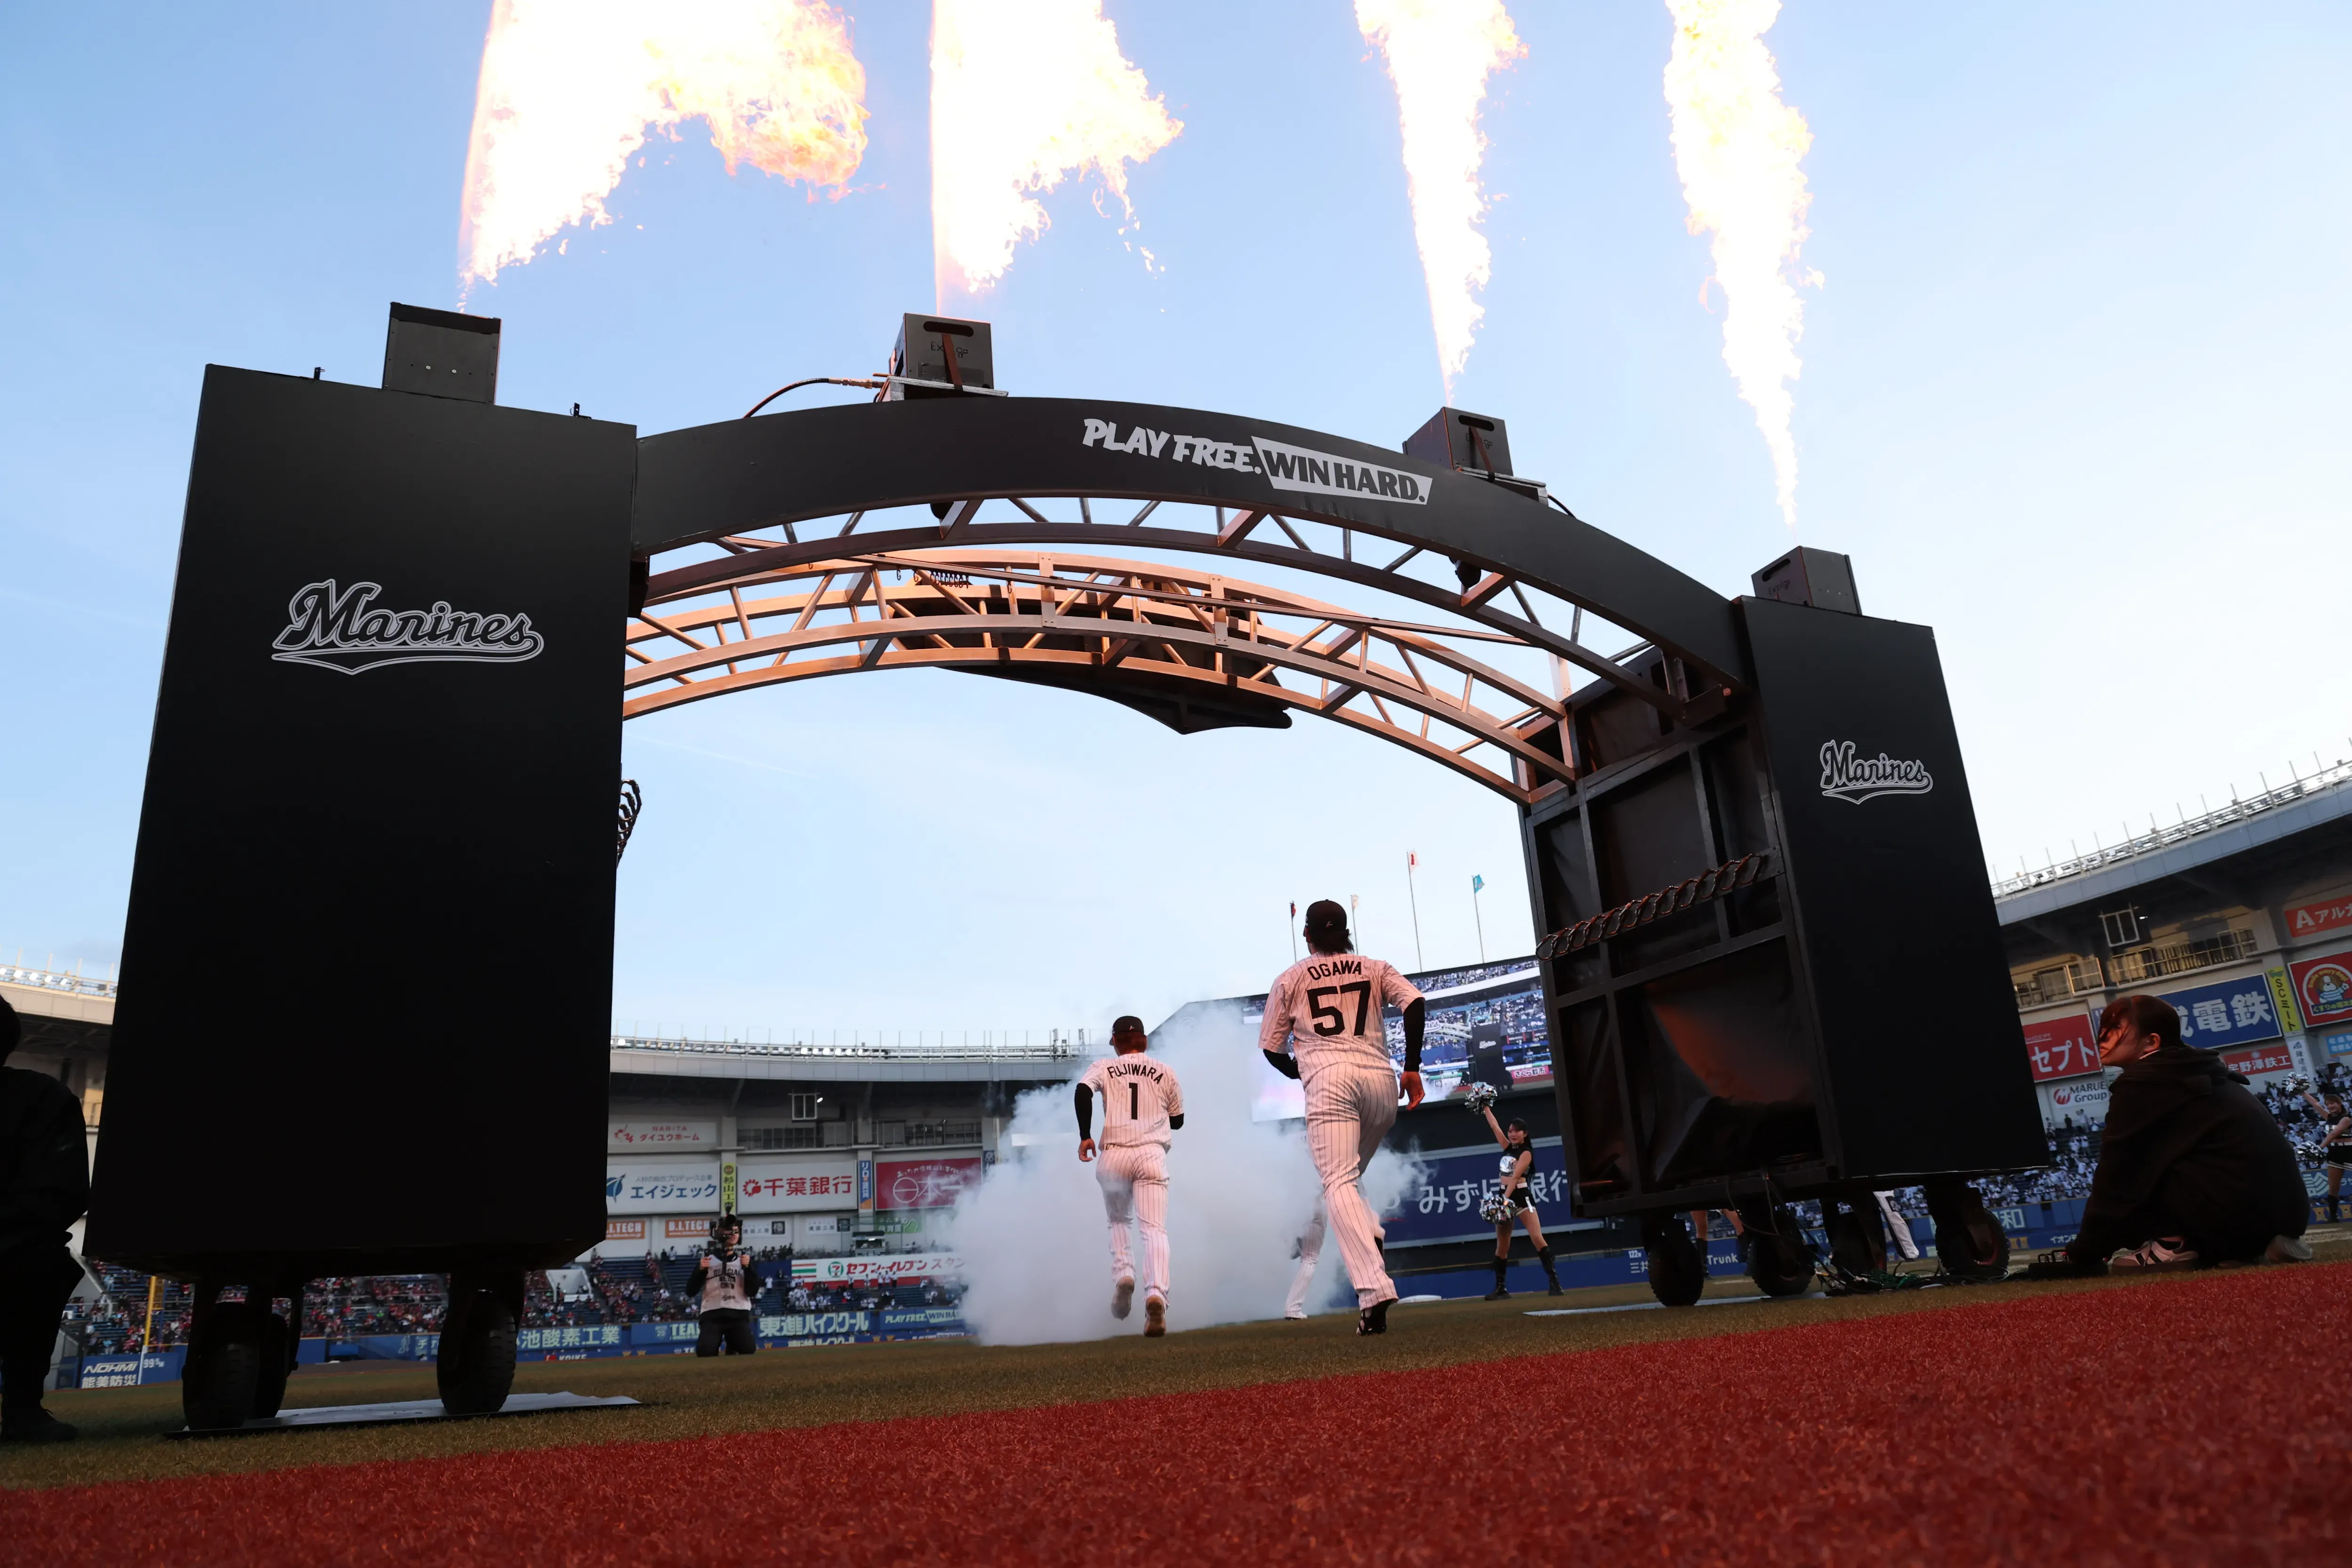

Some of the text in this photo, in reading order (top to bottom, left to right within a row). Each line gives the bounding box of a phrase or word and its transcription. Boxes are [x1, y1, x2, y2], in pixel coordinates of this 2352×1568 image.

[1082, 419, 1425, 502] PLAY FREE. WIN HARD.
[271, 579, 544, 654] Marines
[1820, 740, 1933, 790] Marines
[1307, 961, 1361, 980] OGAWA
[1307, 980, 1371, 1037] 57
[2275, 979, 2296, 1031] SCミート
[2032, 1037, 2095, 1073] セプト
[1107, 1064, 1163, 1084] FUJIWARA
[1514, 1067, 1546, 1078] さくら都市
[1129, 1082, 1137, 1120] 1
[2075, 1091, 2107, 1103] Group
[630, 1184, 717, 1199] エイジェック
[763, 1175, 852, 1196] 千葉銀行
[1992, 1209, 2025, 1229] 和
[1707, 1253, 1738, 1265] Trunk
[759, 1312, 869, 1337] 東進ハイスクール
[885, 1314, 906, 1323] PLAY
[83, 1361, 139, 1374] NOHMI
[81, 1374, 137, 1388] 能美防災
